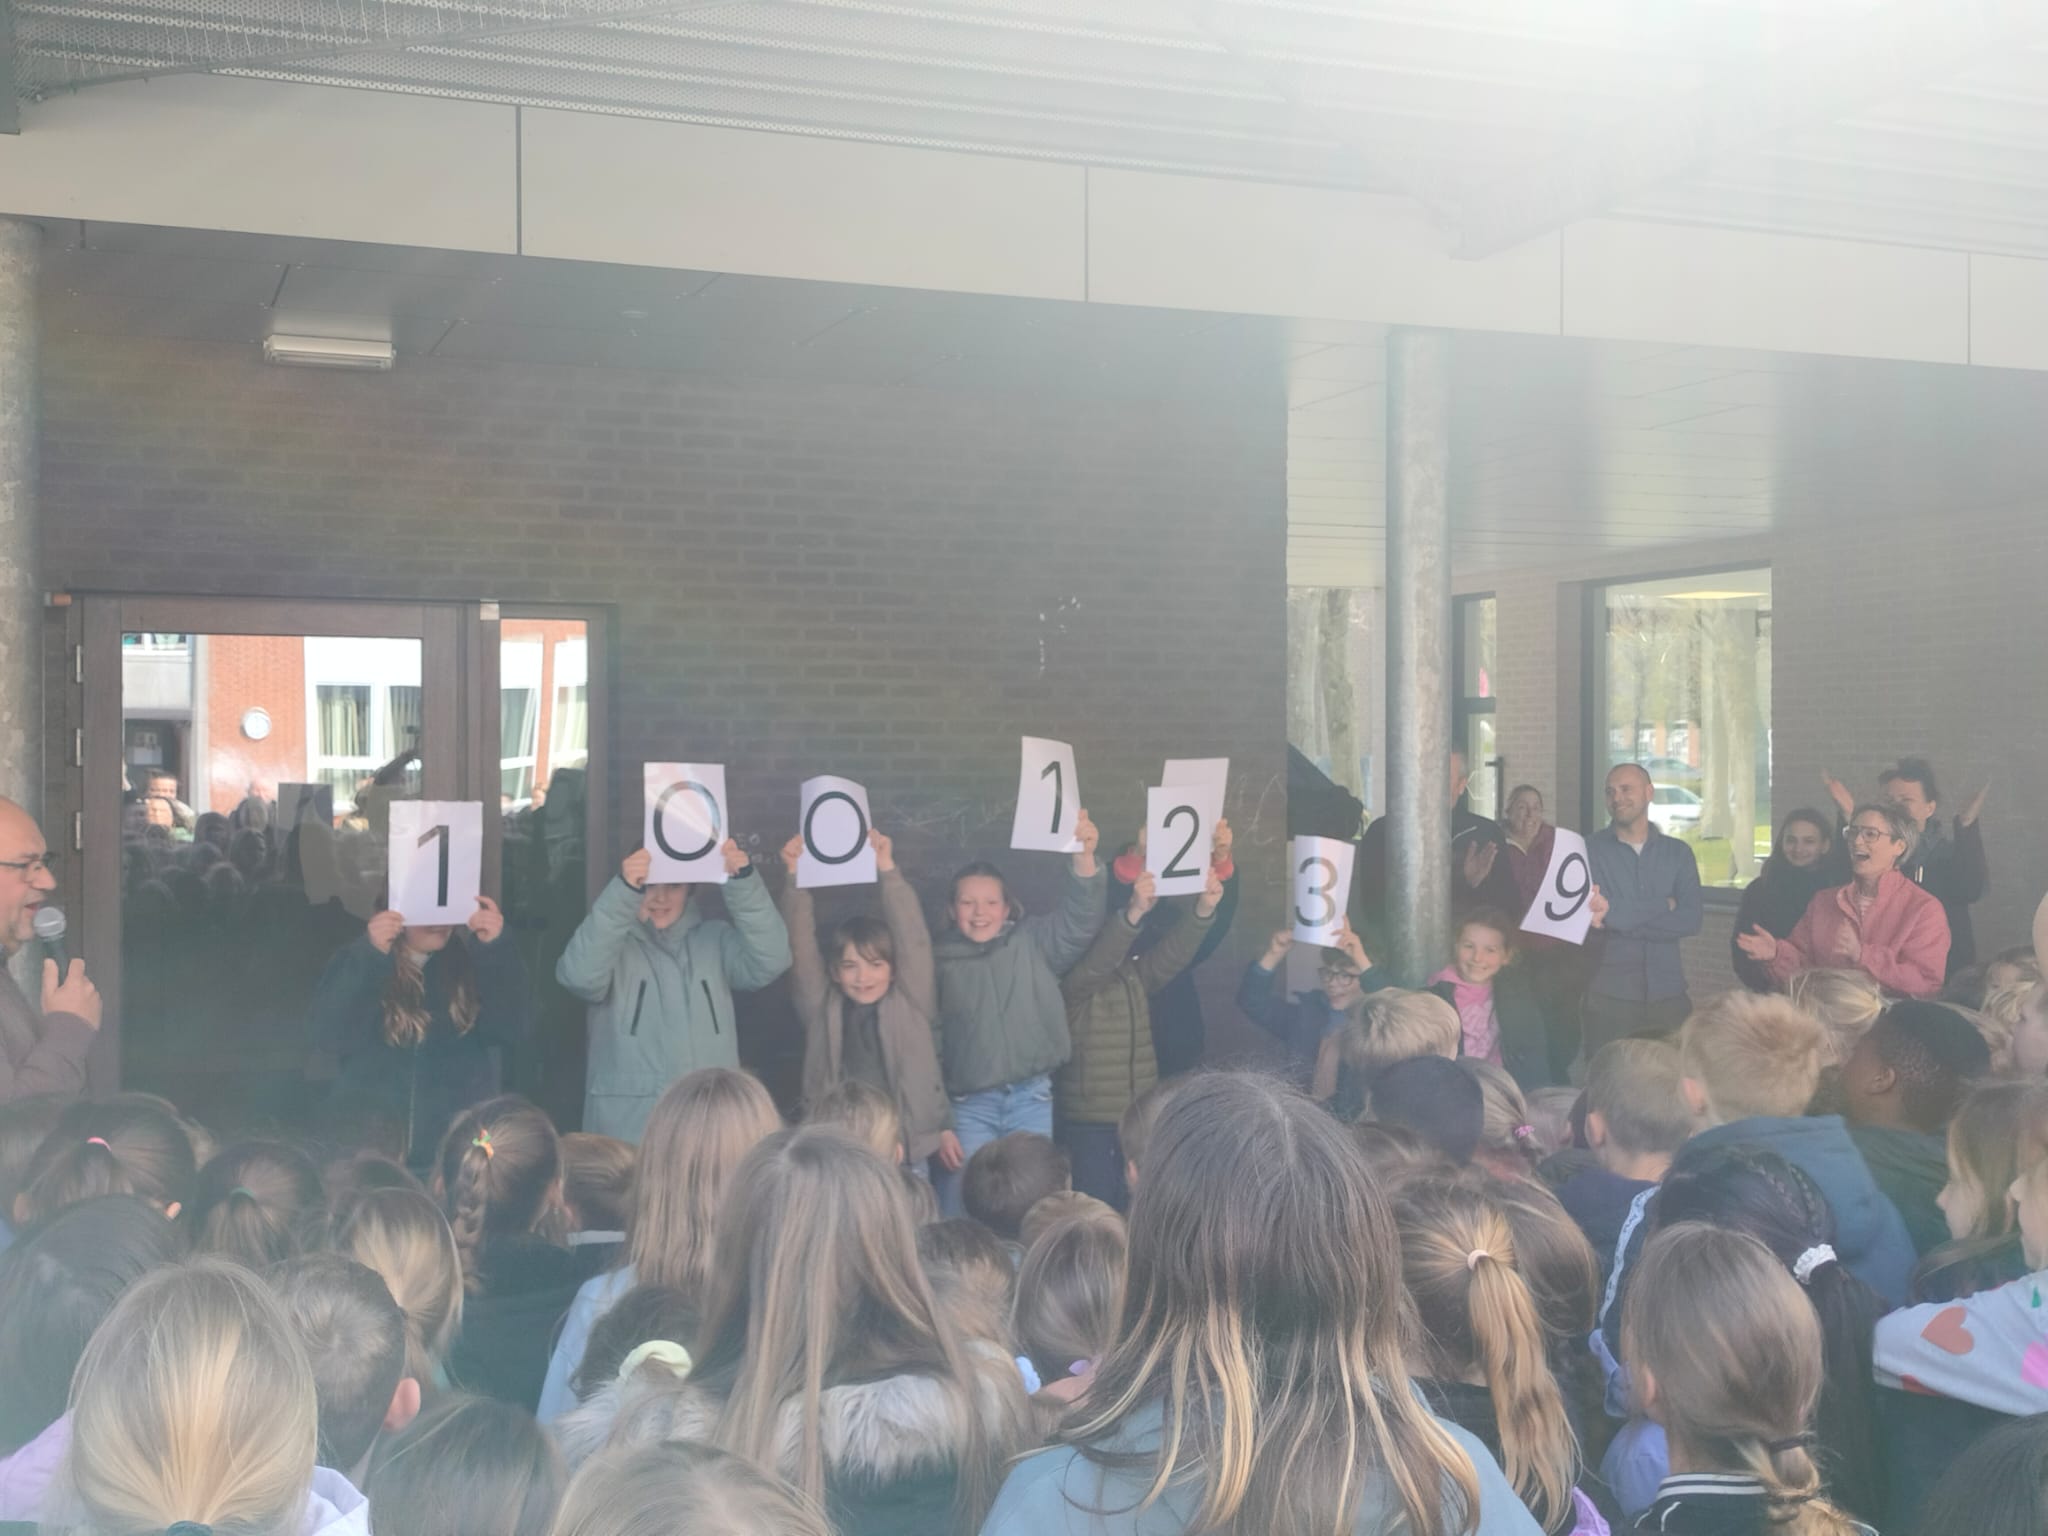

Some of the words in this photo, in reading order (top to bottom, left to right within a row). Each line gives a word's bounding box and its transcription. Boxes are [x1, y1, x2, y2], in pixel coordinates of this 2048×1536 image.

[803, 791, 869, 865] 0
[1041, 761, 1062, 834] 1
[417, 825, 449, 907] 1
[1161, 805, 1201, 879] 2
[1295, 856, 1338, 927] 3
[1545, 853, 1591, 921] 9
